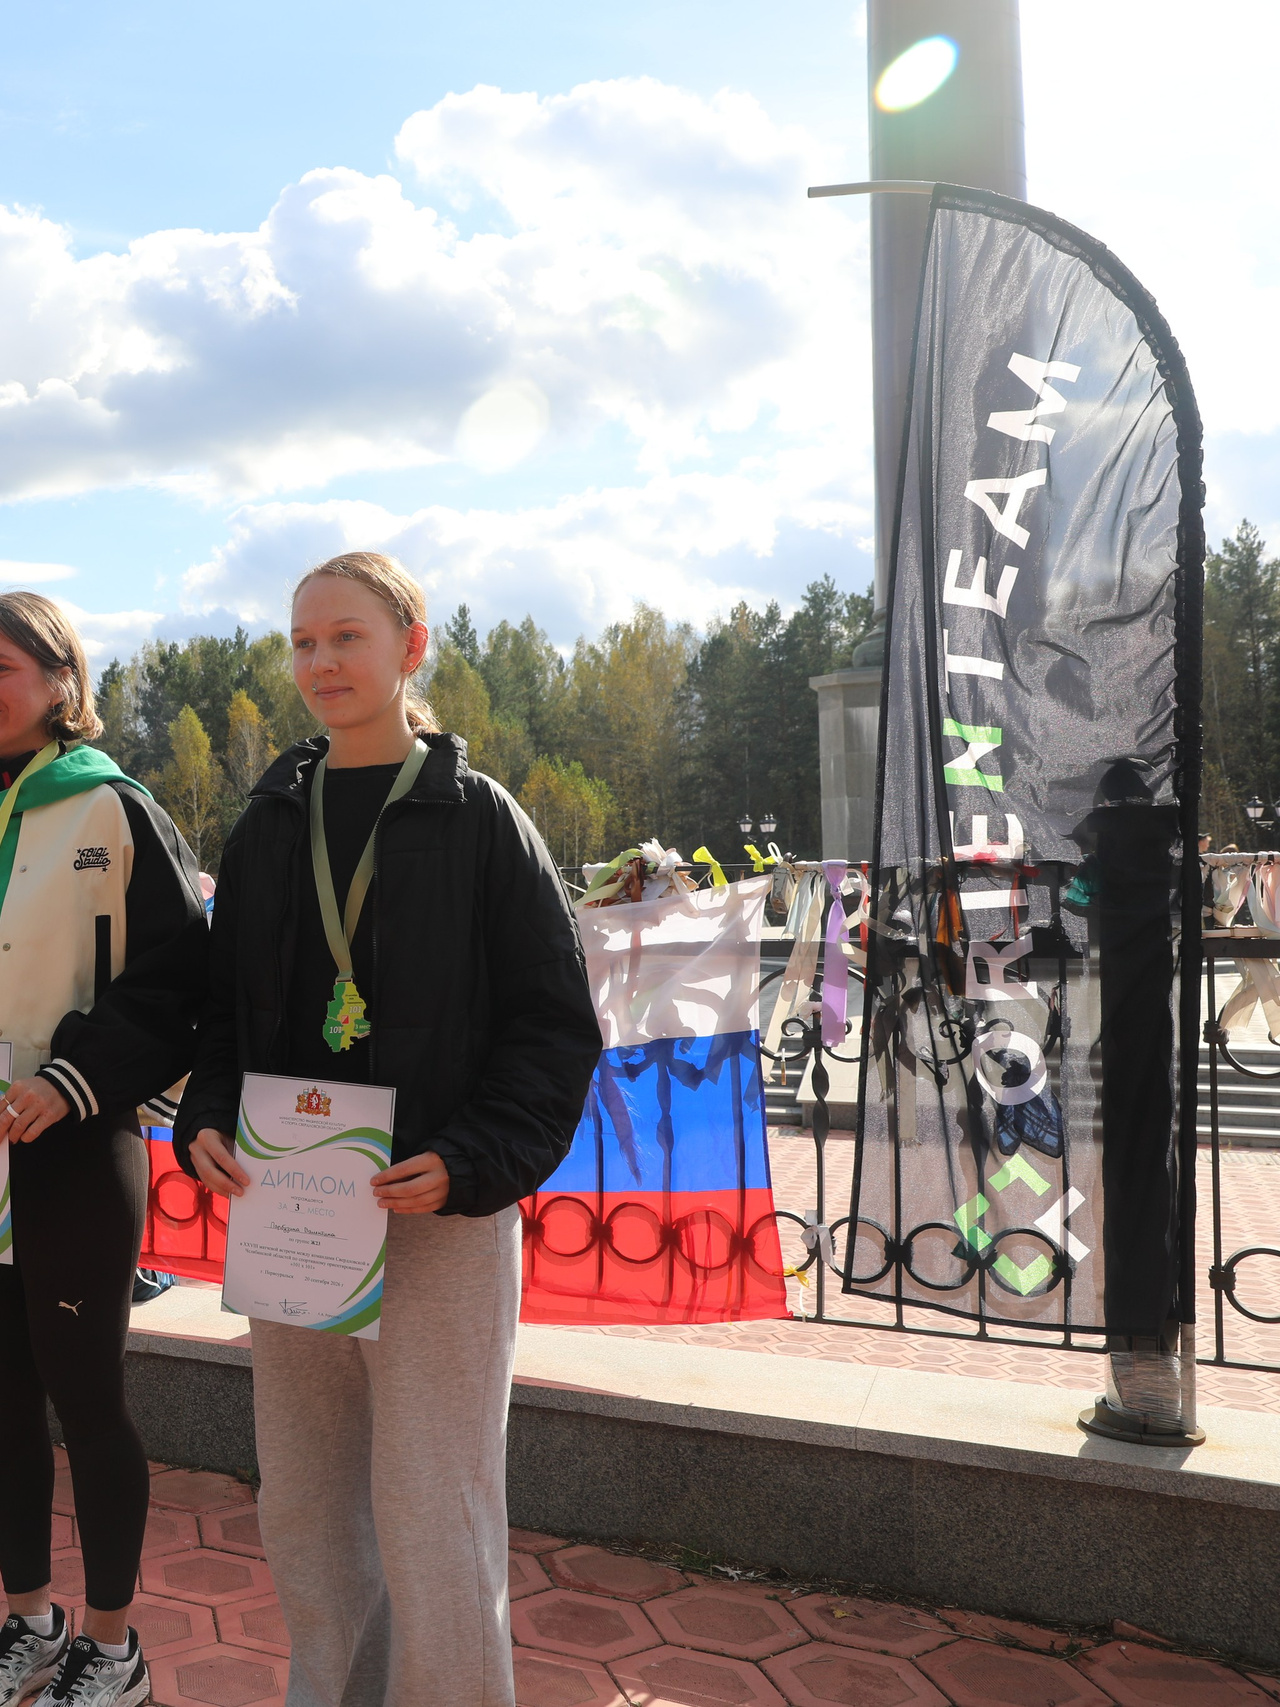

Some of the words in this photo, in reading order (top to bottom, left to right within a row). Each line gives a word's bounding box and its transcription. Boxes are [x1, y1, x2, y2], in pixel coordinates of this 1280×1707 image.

[943, 351, 1083, 1108] ORIENTEAM
[260, 1168, 356, 1198] ДИПЛОМ
[277, 1202, 288, 1211] ЗА
[294, 1203, 300, 1212] 3
[307, 1207, 336, 1218] МЕСТО
